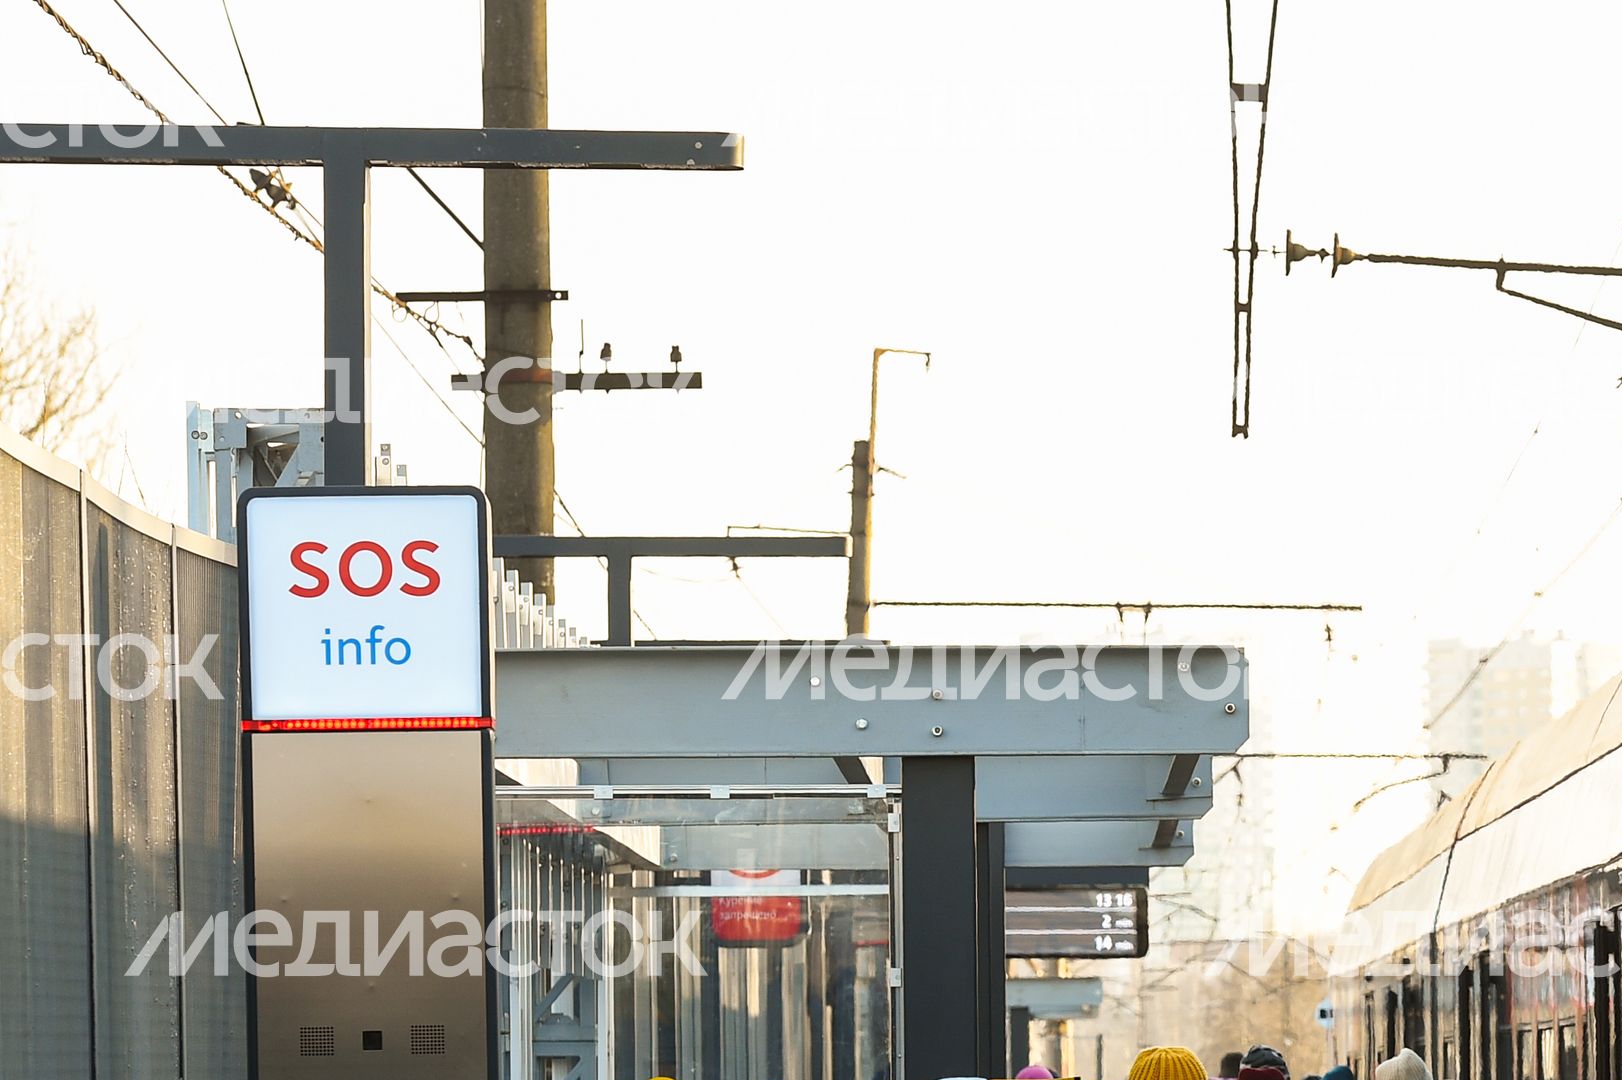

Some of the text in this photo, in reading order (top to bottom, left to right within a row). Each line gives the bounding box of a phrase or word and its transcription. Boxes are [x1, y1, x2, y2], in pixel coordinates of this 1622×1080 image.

[288, 540, 441, 598] SOS
[321, 625, 411, 666] info
[1101, 913, 1112, 929] 2
